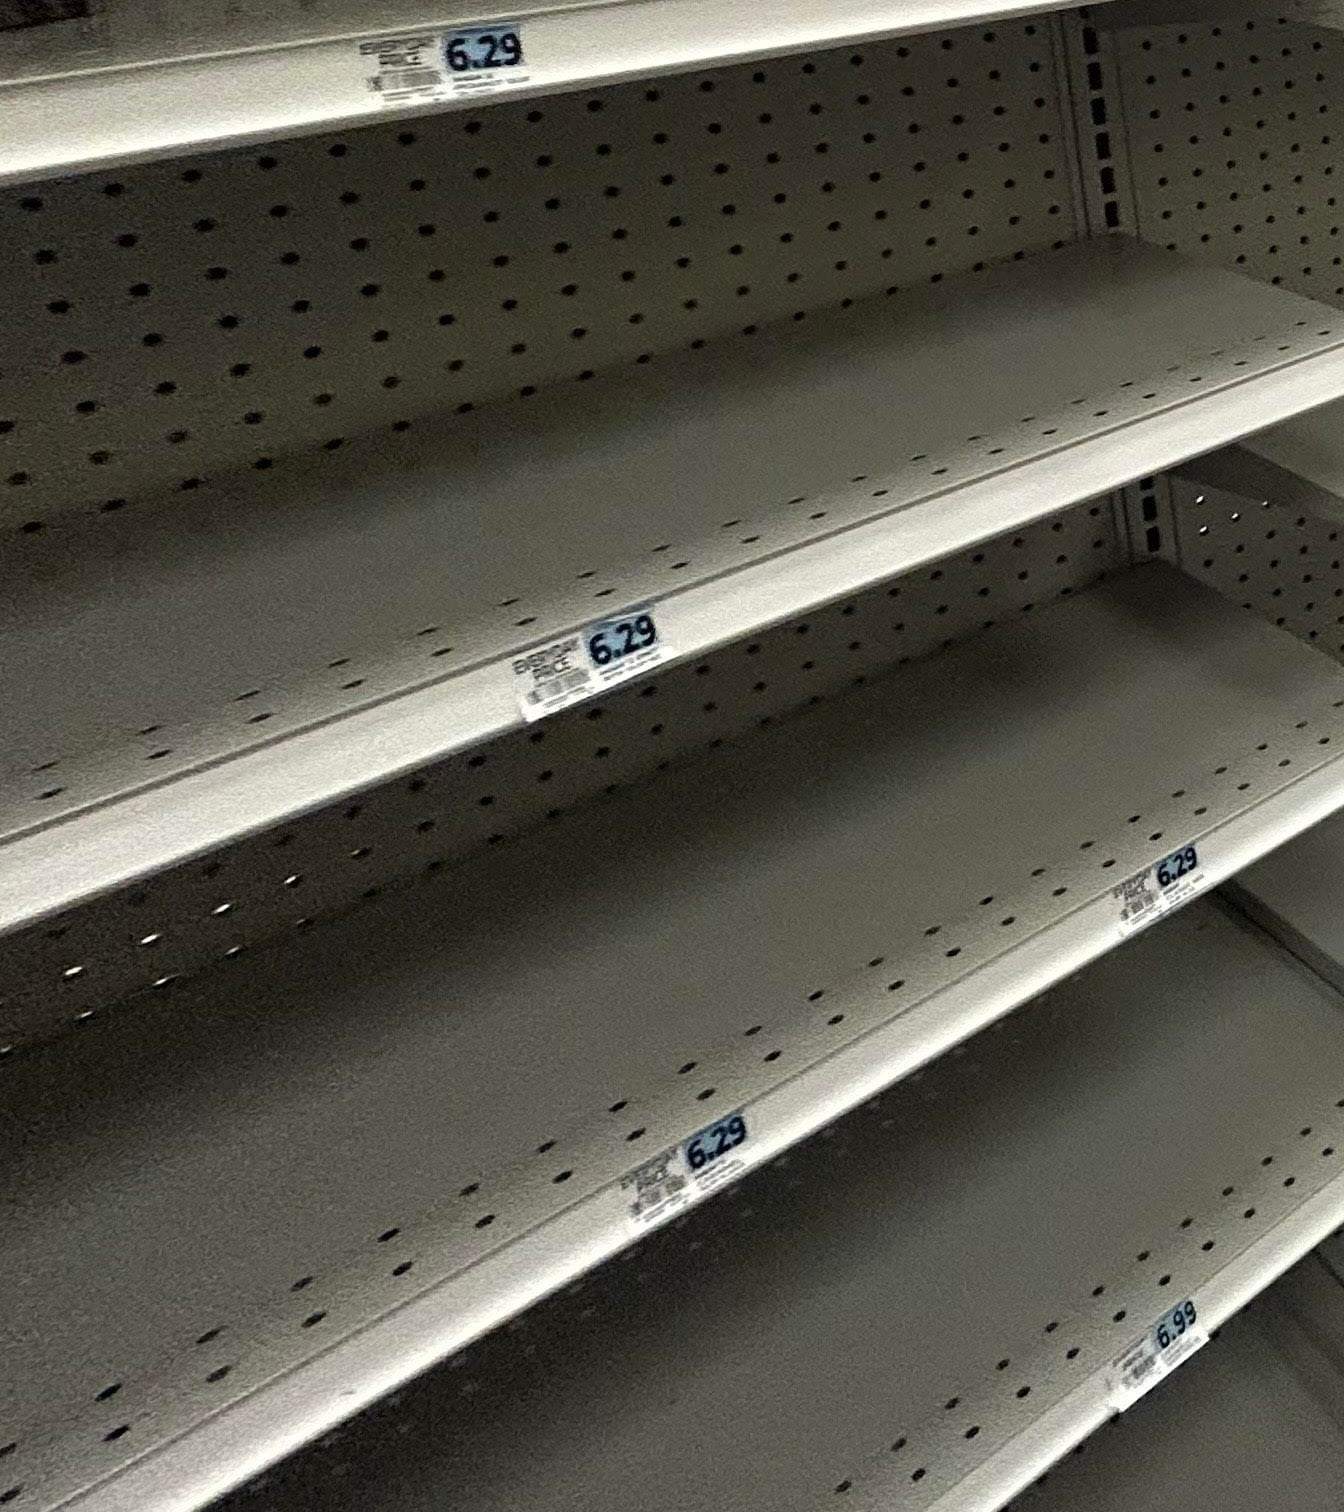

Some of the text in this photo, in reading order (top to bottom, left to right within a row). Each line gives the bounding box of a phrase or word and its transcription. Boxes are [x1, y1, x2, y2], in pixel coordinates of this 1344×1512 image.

[445, 32, 523, 72] 6.29
[589, 614, 658, 665] 6.29
[1157, 846, 1197, 887] 6.29
[687, 1115, 747, 1170] 6.29
[1156, 1300, 1197, 1349] 6.99
